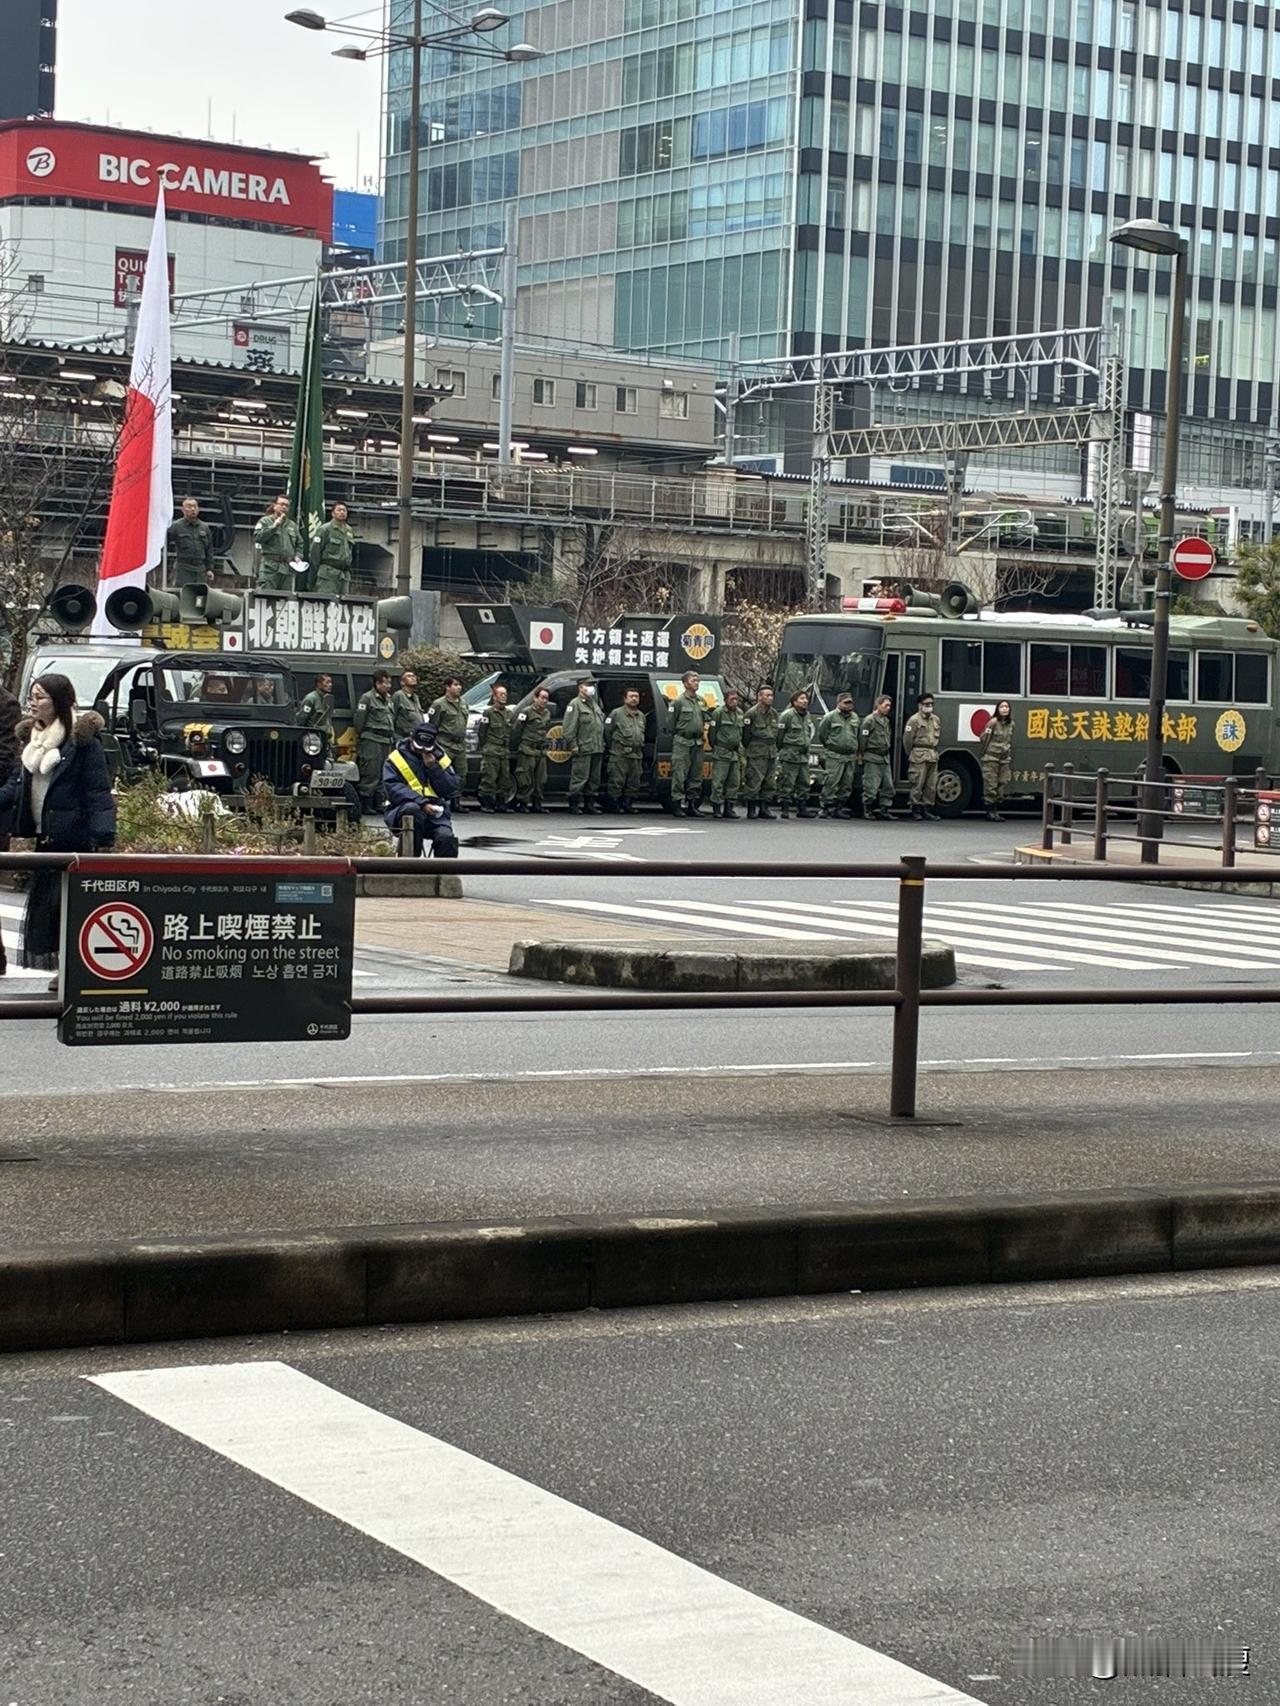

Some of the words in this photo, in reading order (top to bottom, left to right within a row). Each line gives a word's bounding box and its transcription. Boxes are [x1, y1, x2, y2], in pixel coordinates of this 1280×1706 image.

[98, 154, 151, 186] BIC
[160, 163, 291, 205] CAMERA
[248, 598, 376, 654] 北朝鮮粉砕
[575, 626, 670, 648] 北方領土返還
[575, 647, 670, 668] 失地領土回復
[80, 879, 140, 893] 千代田区内
[152, 885, 181, 894] Chiyoda
[182, 885, 197, 894] City
[162, 913, 322, 941] 路上喫煙禁止
[162, 946, 183, 960] No
[186, 945, 247, 963] smoking
[251, 949, 269, 960] on
[273, 945, 296, 960] the
[300, 945, 340, 960] street
[161, 965, 243, 980] 道路禁止吸烟
[252, 964, 279, 980] 노상
[282, 964, 308, 979] 흡연
[312, 964, 338, 979] 금지
[119, 1001, 141, 1013] 過料
[144, 1001, 180, 1013] ¥2,000
